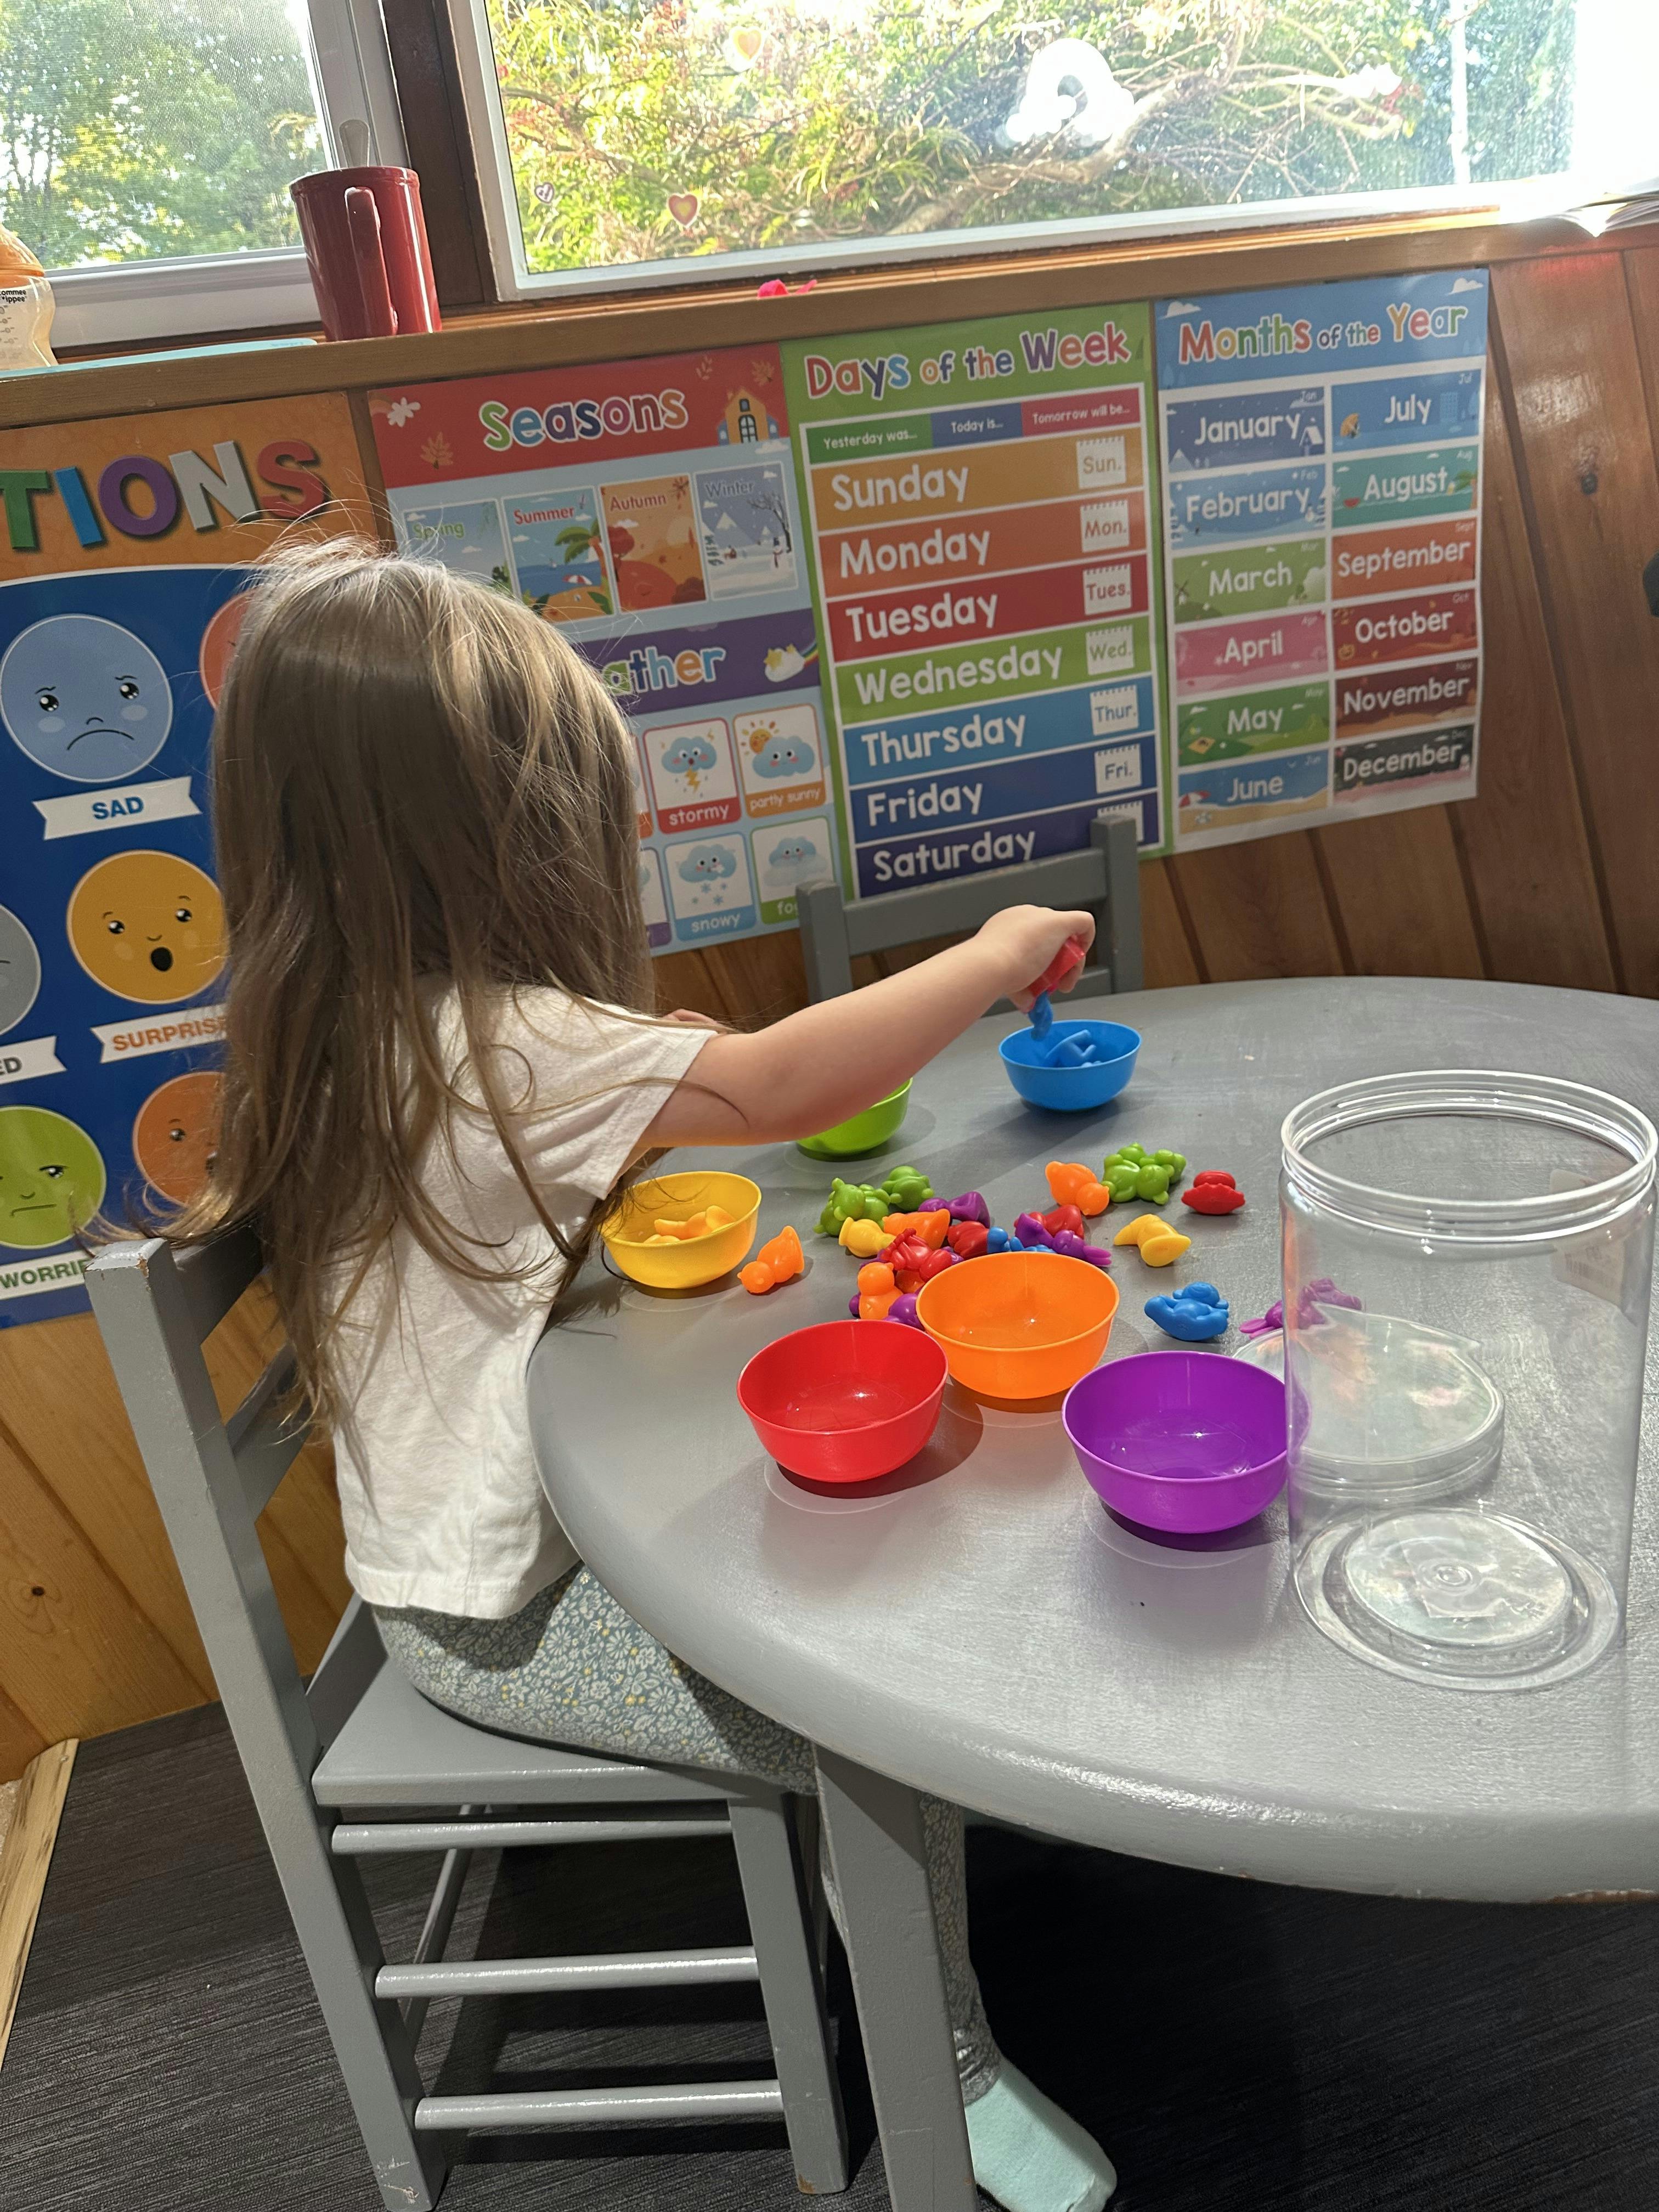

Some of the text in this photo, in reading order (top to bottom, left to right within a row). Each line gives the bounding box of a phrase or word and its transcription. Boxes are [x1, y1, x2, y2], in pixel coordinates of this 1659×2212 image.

[1179, 302, 1468, 364] Months of the Year
[805, 322, 1131, 400] Days of the Week
[1458, 373, 1472, 385] Jul
[1300, 390, 1316, 402] Jan
[1384, 394, 1431, 425] July
[479, 390, 687, 451] Seasons
[951, 419, 984, 433] Today
[1032, 409, 1087, 424] Tomorrow
[1091, 406, 1108, 416] will
[1194, 413, 1300, 445] January
[823, 433, 882, 449] Yesterday
[1084, 454, 1122, 473] Sun.
[1457, 450, 1472, 462] Aug
[0, 440, 326, 550] TIONS
[706, 479, 754, 497] Winter
[831, 464, 969, 511] Sunday
[1364, 466, 1448, 501] August
[514, 505, 575, 526] Summer
[610, 494, 667, 511] Autumn
[1186, 488, 1310, 522] February
[413, 522, 466, 540] Sping
[1084, 521, 1127, 538] Mon.
[840, 528, 990, 578] Monday
[1338, 540, 1470, 577] September
[1086, 584, 1131, 601] Tues.
[1209, 562, 1291, 596] March
[845, 592, 997, 642] Tuesday
[1355, 610, 1454, 643] October
[1090, 647, 1132, 659] Wed.
[1223, 630, 1283, 665] April
[602, 646, 726, 696] ather
[854, 646, 1063, 704] Wednesday
[1343, 675, 1469, 714] November
[1095, 703, 1138, 723] Thur.
[1227, 708, 1283, 734] May
[861, 714, 1026, 766] Thursday
[1105, 761, 1134, 781] Fri.
[1343, 742, 1462, 781] December
[750, 788, 821, 811] partly sunny
[1227, 775, 1283, 802] June
[93, 797, 143, 820] SAD
[669, 803, 729, 825] stormy
[867, 783, 983, 826] Friday
[873, 831, 1036, 882] Saturday
[691, 912, 740, 933] snowy
